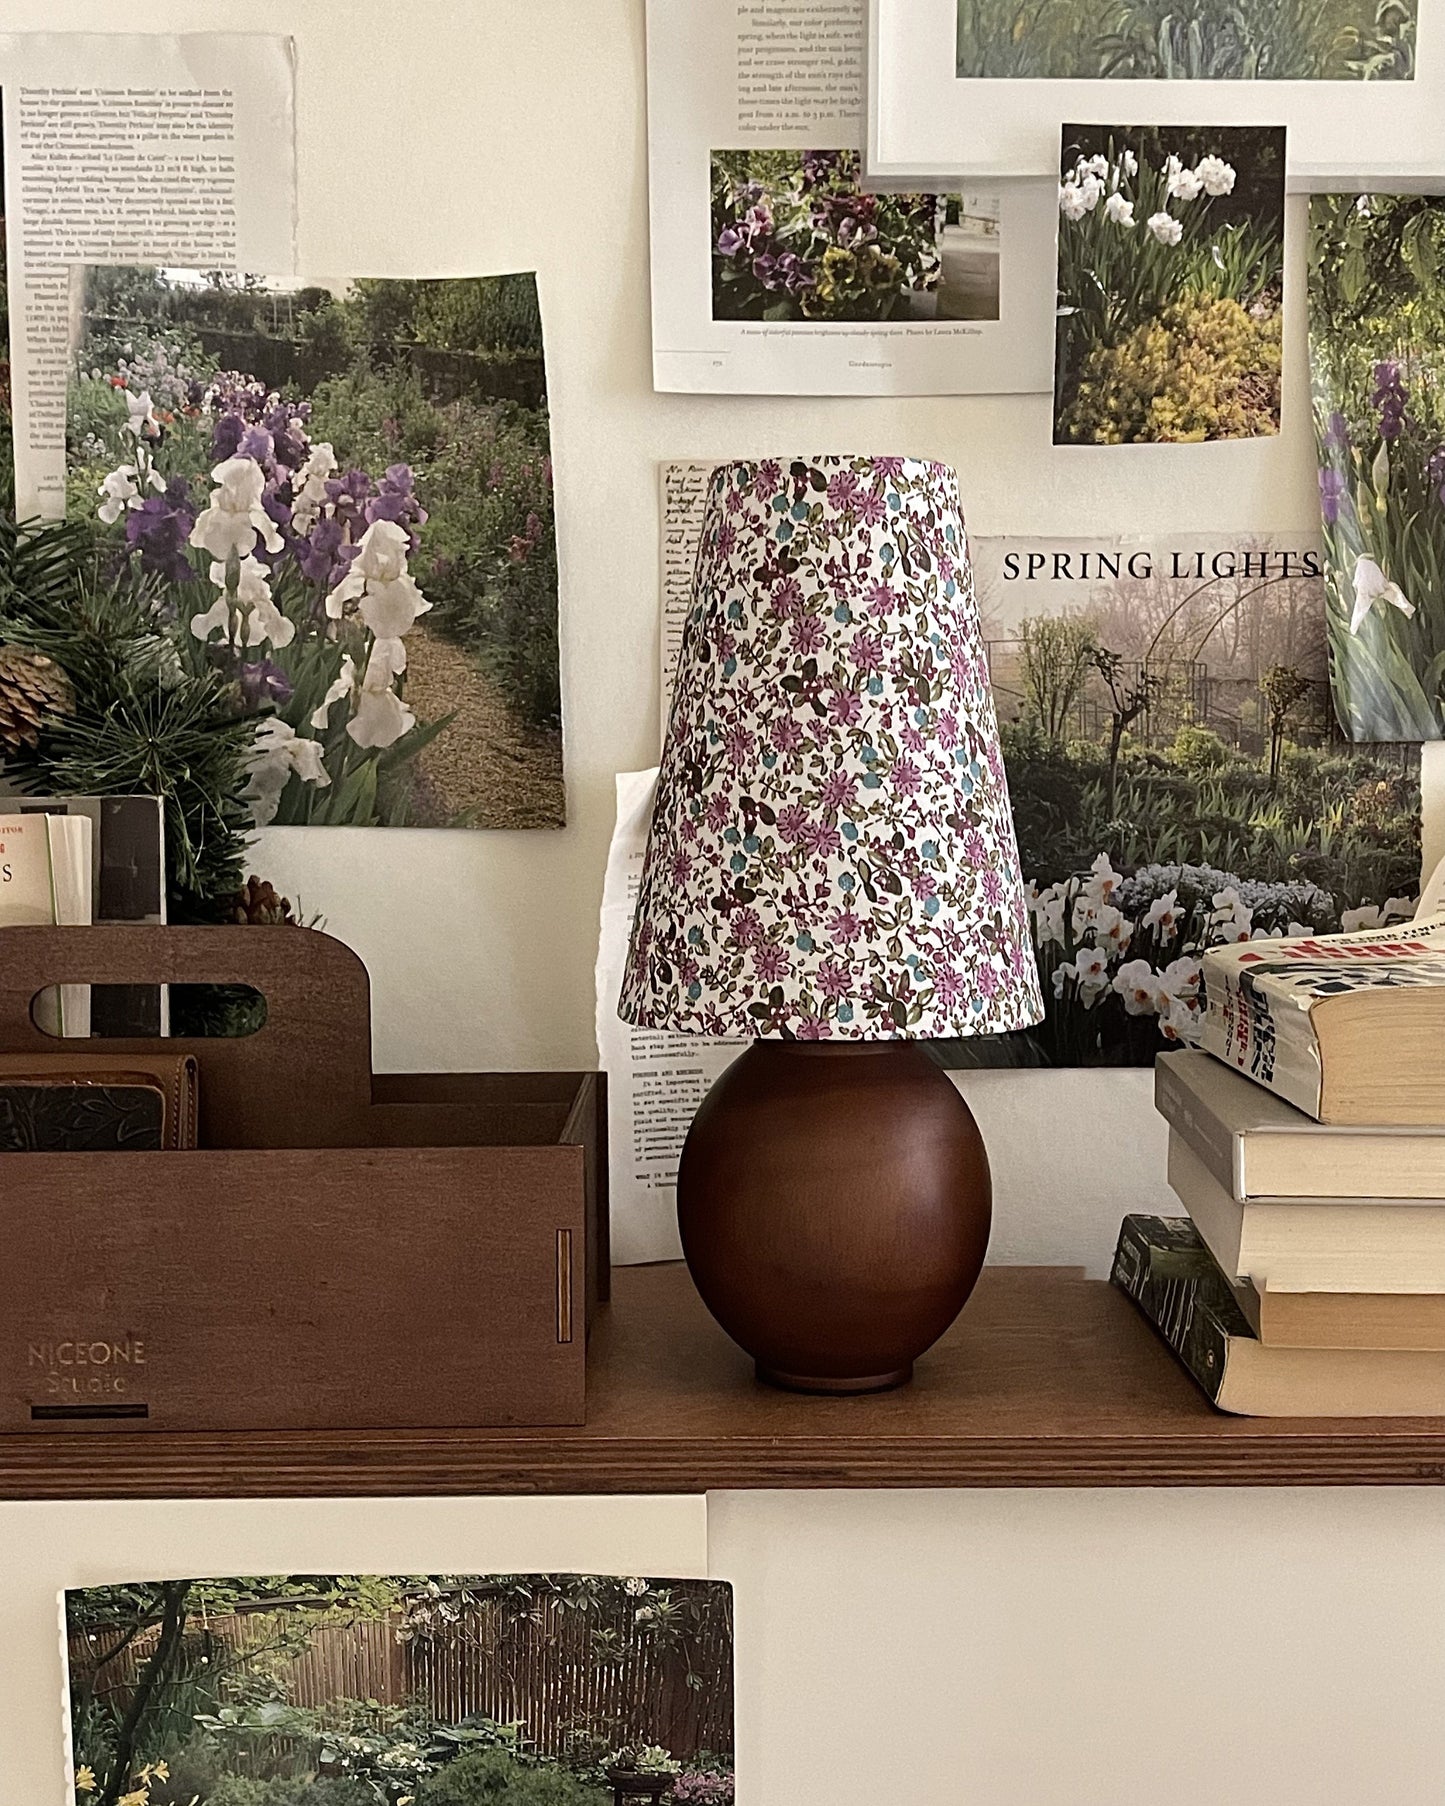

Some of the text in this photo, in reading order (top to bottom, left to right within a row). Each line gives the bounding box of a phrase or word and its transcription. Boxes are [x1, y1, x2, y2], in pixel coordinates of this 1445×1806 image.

[1003, 551, 1323, 581] SPRING LIGHTS
[28, 1341, 147, 1367] NICEONE
